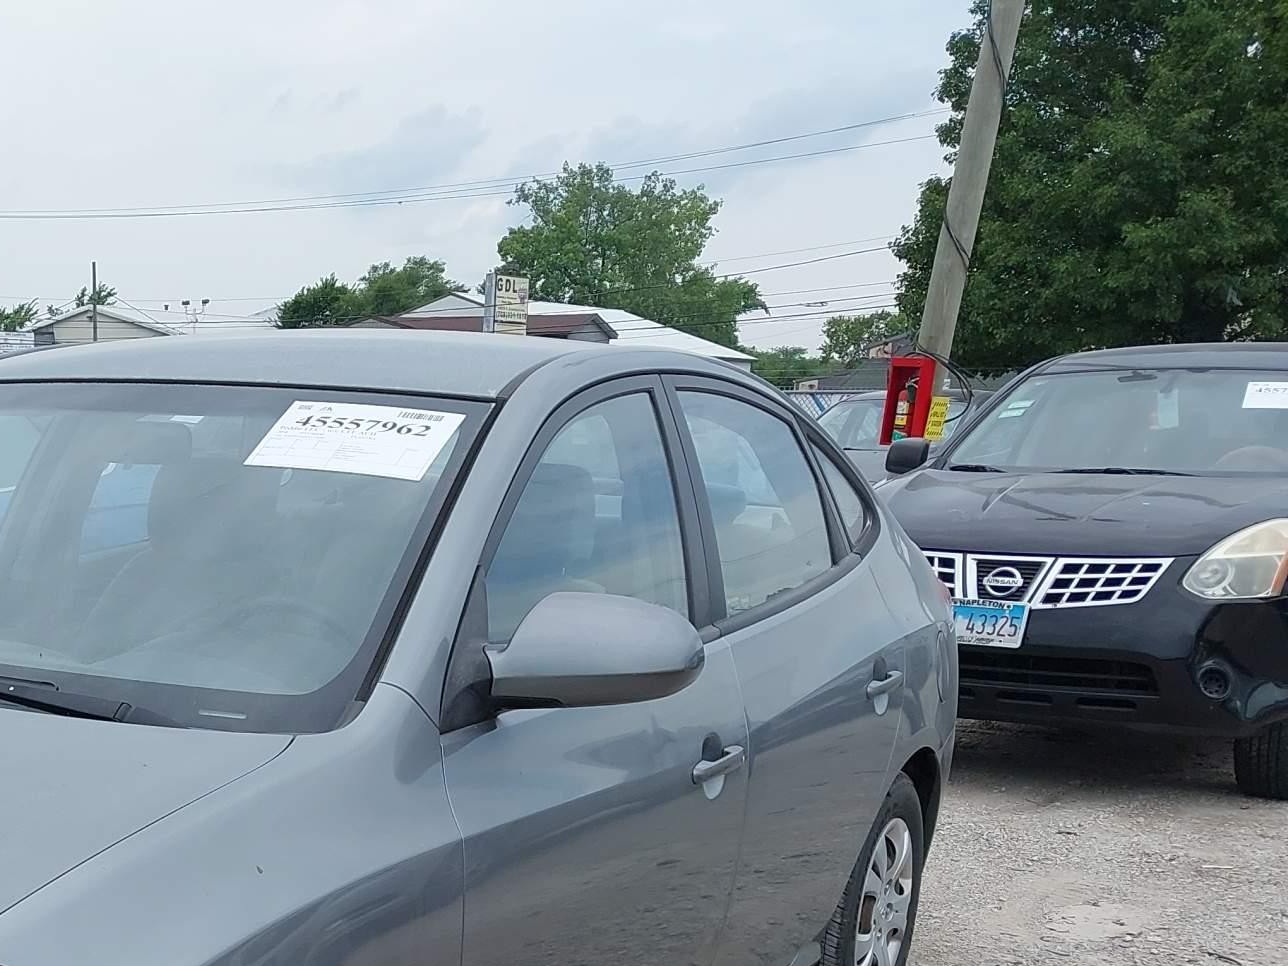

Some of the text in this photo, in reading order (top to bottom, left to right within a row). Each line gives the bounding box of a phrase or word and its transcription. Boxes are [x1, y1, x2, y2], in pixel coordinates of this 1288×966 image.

[497, 277, 518, 293] GDL
[295, 415, 432, 437] 45557962
[959, 599, 1006, 609] NAPLETON
[965, 612, 1021, 637] 43325
